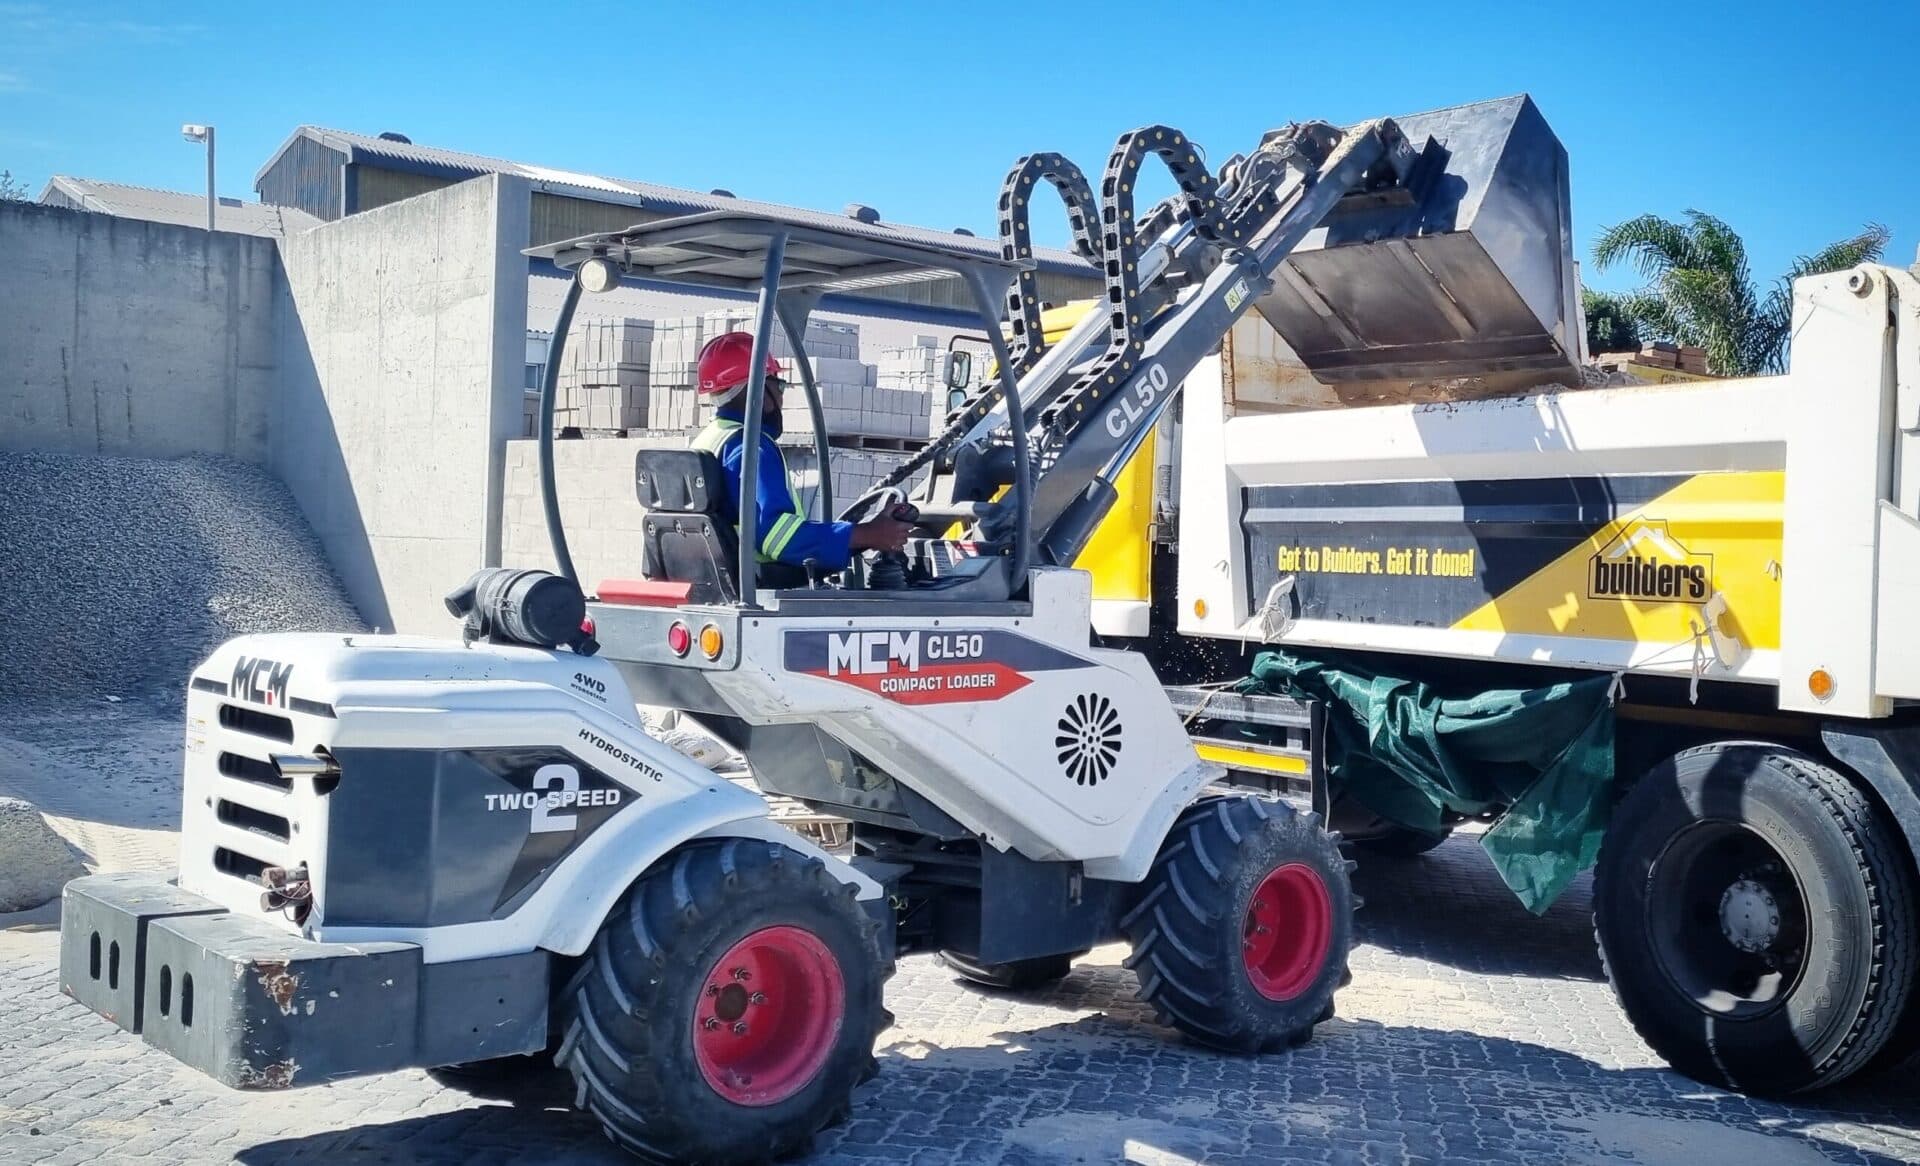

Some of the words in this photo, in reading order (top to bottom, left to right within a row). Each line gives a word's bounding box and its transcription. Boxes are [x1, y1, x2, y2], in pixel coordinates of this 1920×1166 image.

[1106, 363, 1169, 438] CL50
[1278, 546, 1301, 571] Get
[1305, 547, 1319, 572] to
[1321, 547, 1383, 574] Builders.
[1387, 547, 1412, 575] Get
[1415, 548, 1428, 575] it
[1432, 548, 1475, 577] done!
[1594, 555, 1705, 598] builders
[828, 631, 920, 676] MCM
[927, 635, 983, 659] CL50
[231, 655, 294, 709] MCM
[574, 672, 605, 693] 4WD
[880, 676, 943, 693] COMPACT
[947, 674, 996, 689] LOADER
[578, 728, 664, 782] HYDROSTATIC
[484, 791, 539, 811] TWO
[546, 789, 621, 808] SPEED
[530, 764, 580, 833] 2
